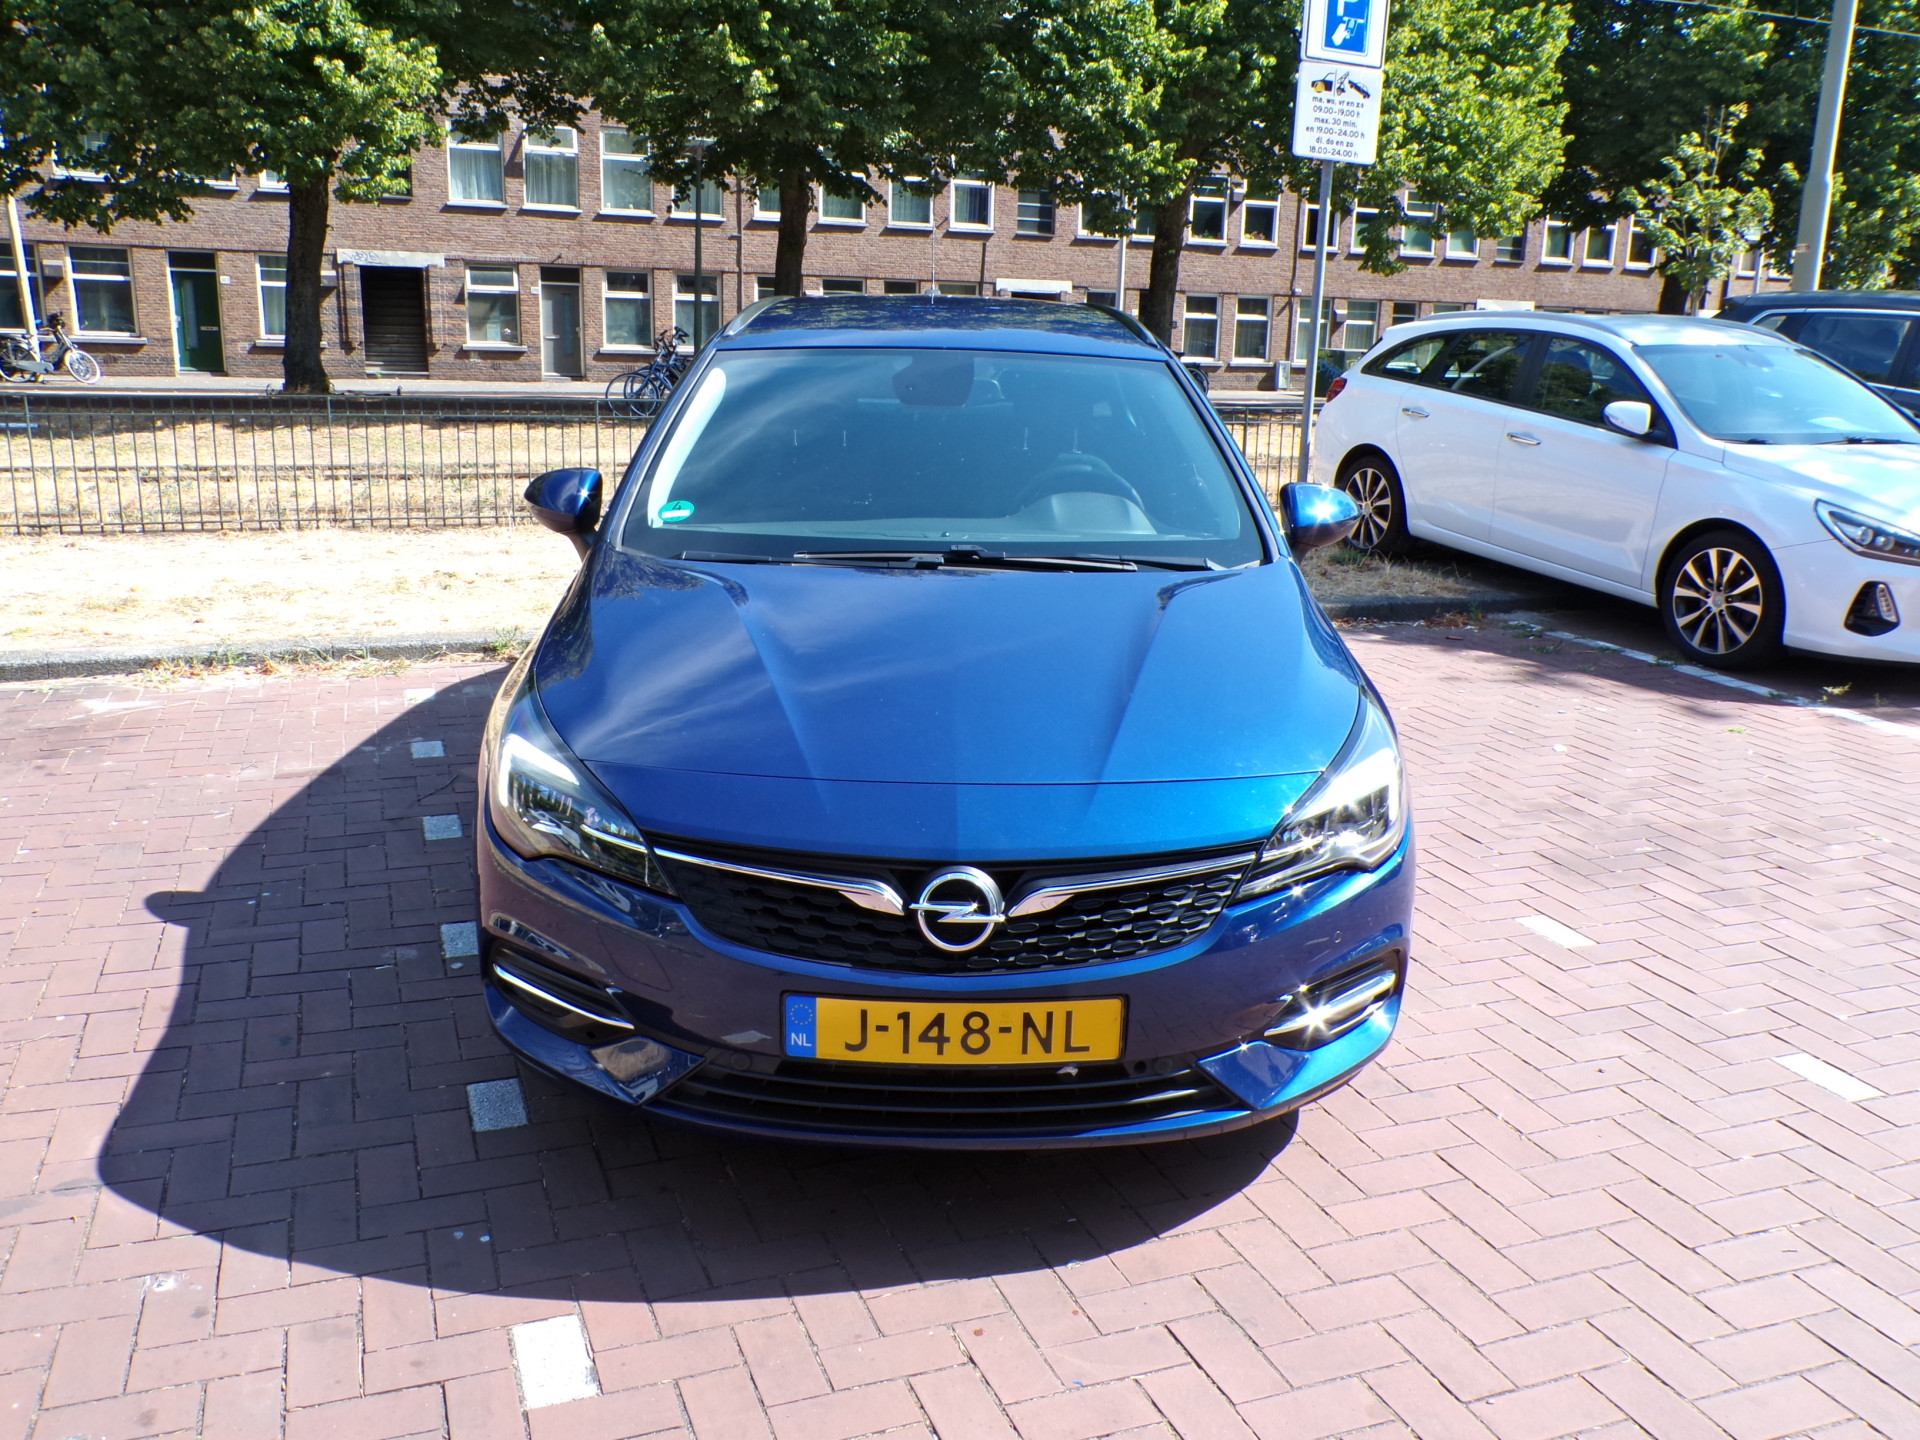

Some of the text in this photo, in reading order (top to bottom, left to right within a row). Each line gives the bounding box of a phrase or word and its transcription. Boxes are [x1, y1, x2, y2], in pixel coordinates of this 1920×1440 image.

[1314, 116, 1358, 128] max. 30 min.
[1316, 126, 1360, 138] 19.00-24.00
[1360, 132, 1366, 140] h
[1325, 137, 1335, 146] do
[1309, 145, 1353, 157] 18.00-24.00
[672, 501, 681, 511] 4
[791, 1008, 1091, 1056] NL J-148-NL
